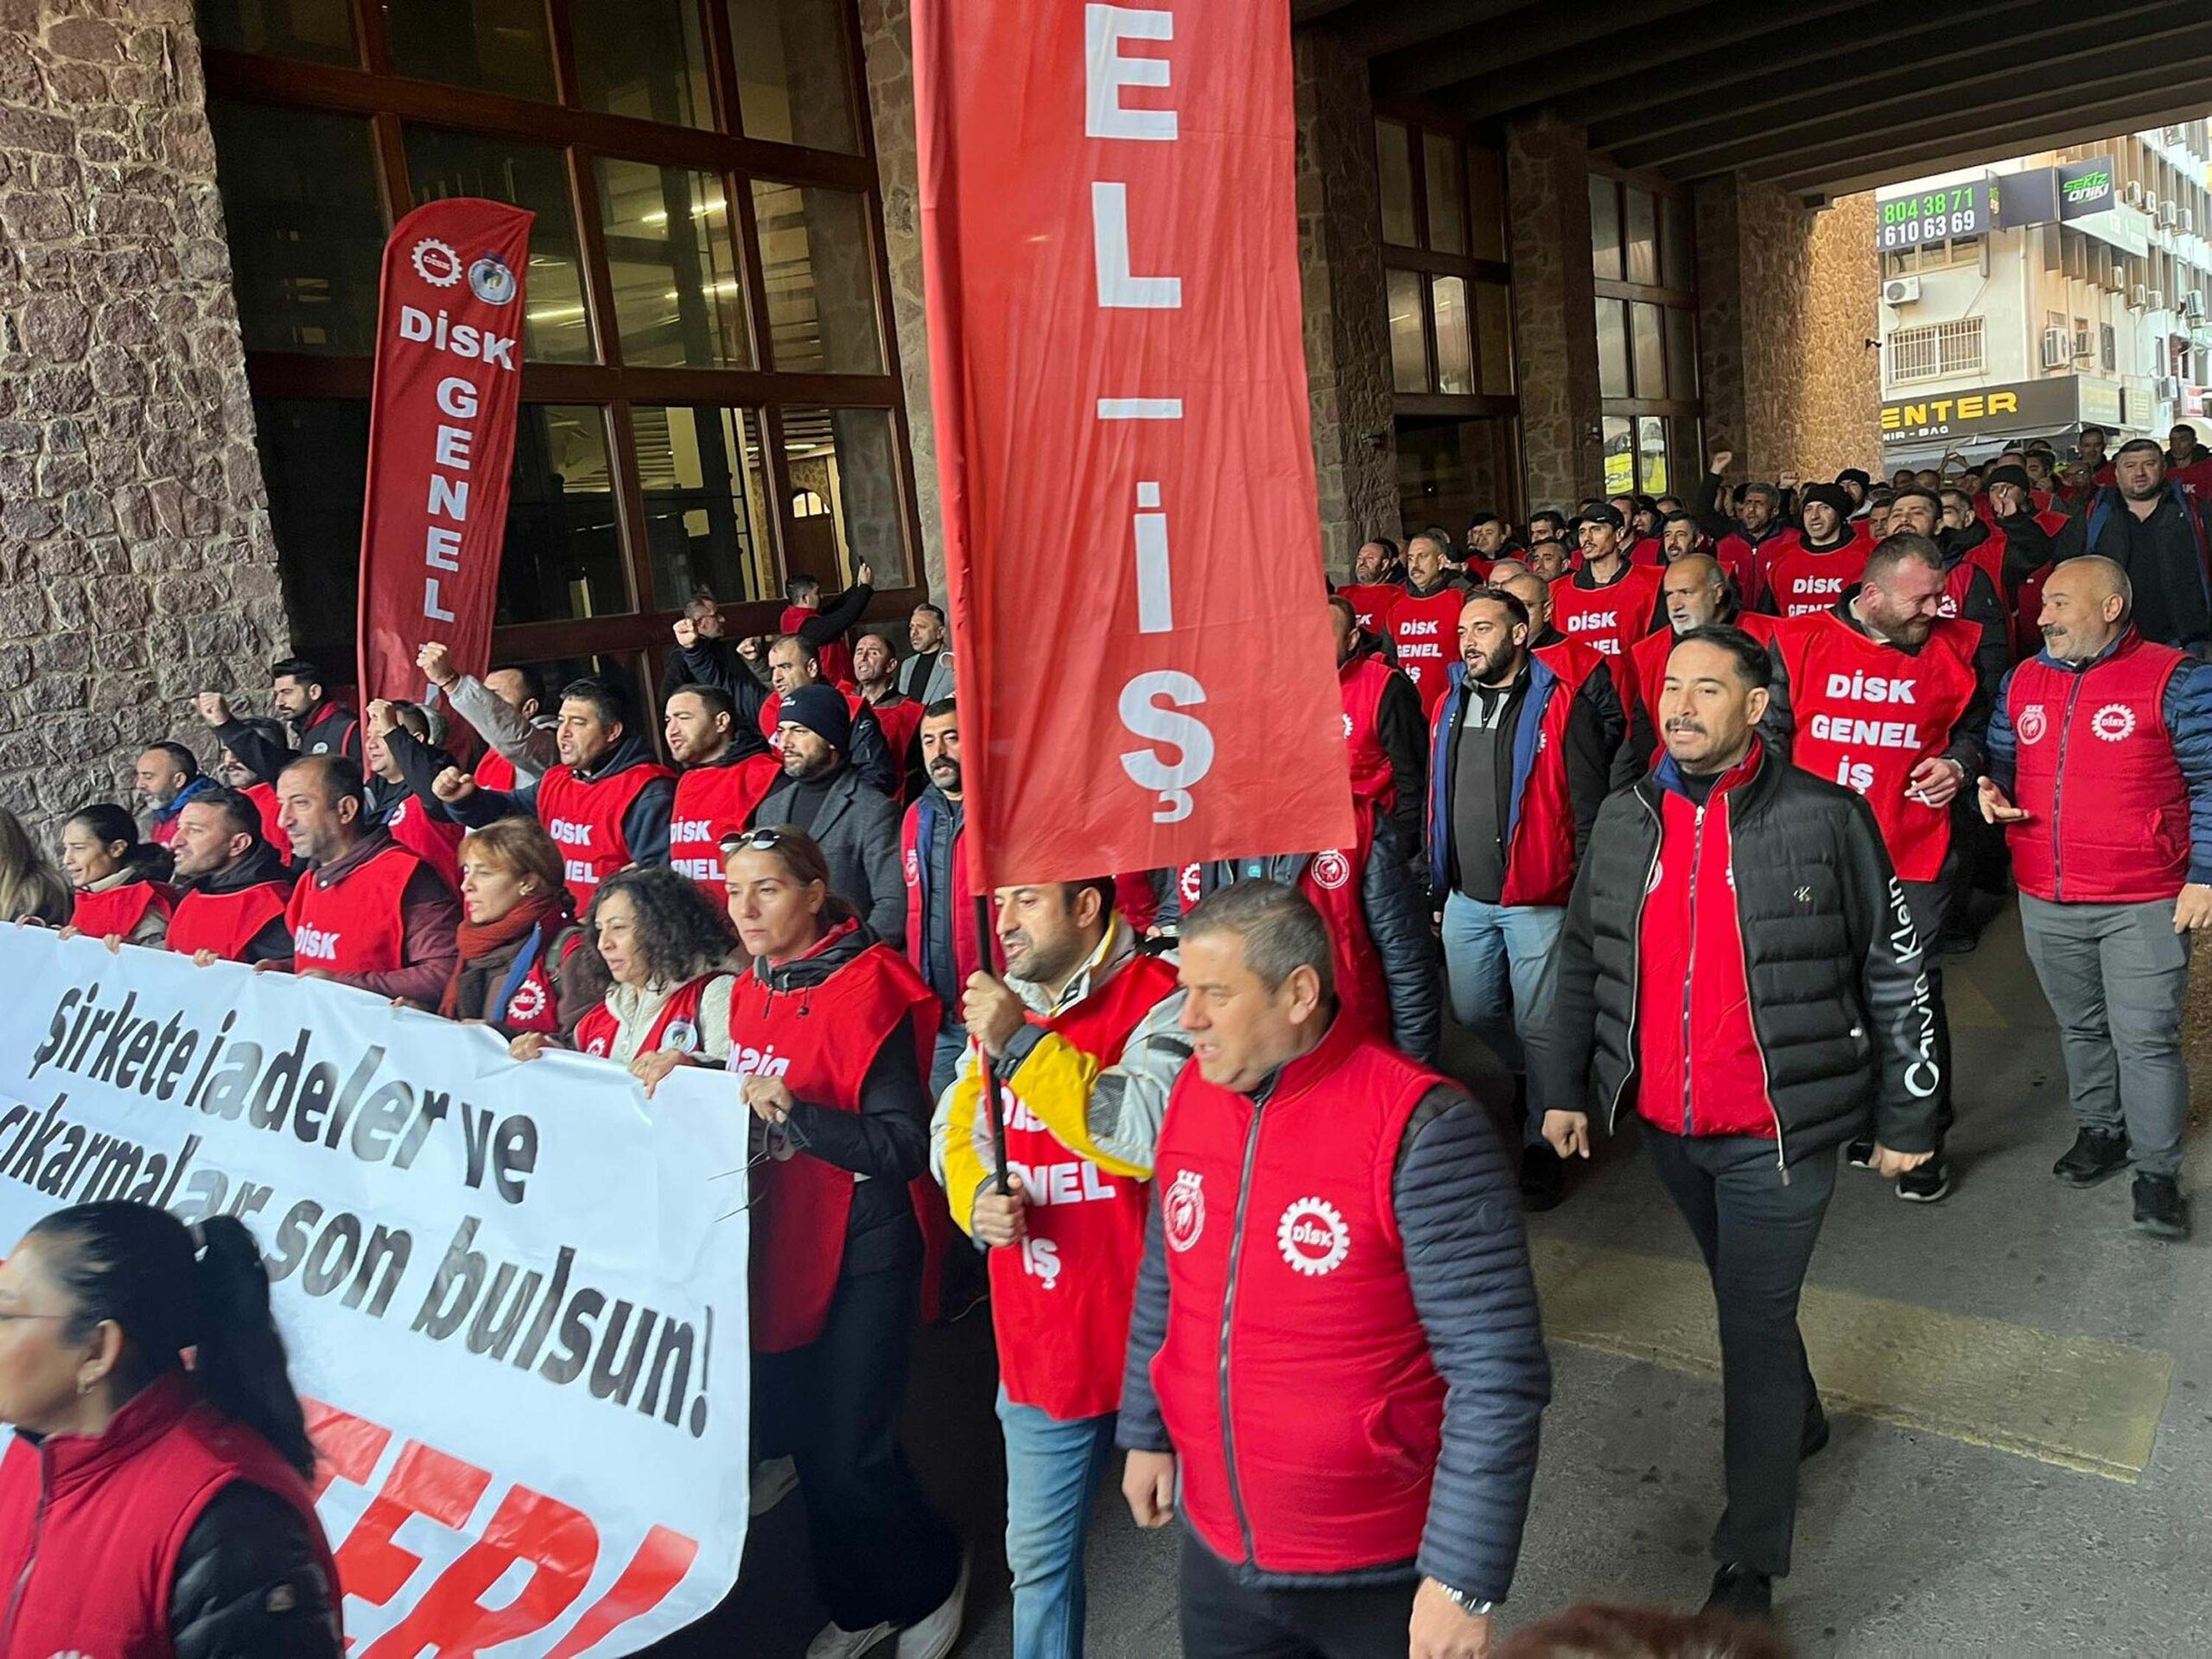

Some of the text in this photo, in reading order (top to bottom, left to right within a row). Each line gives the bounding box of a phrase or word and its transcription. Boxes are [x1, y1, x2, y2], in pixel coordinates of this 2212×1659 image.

[1885, 199, 1919, 224] 804
[1923, 193, 1947, 217] 38
[1951, 187, 1974, 211] 71
[1885, 221, 1919, 246] 610
[1923, 215, 1947, 239] 63
[1951, 209, 1975, 233] 69
[399, 305, 517, 372] DİSK
[1879, 391, 2018, 429] ENTER
[1792, 575, 1844, 594] DİSK
[1400, 619, 1440, 636] DİSK
[1567, 610, 1618, 632] DİSK
[1825, 669, 1916, 704] DİSK
[1811, 713, 1922, 750] GENEL
[1836, 754, 1875, 795] İŞ
[295, 920, 341, 960] DİSK
[28, 982, 538, 1204] şirkete iadeler ve
[1292, 1219, 1335, 1248] DİSK
[263, 1199, 412, 1319] son
[409, 1215, 714, 1440] bulsun!
